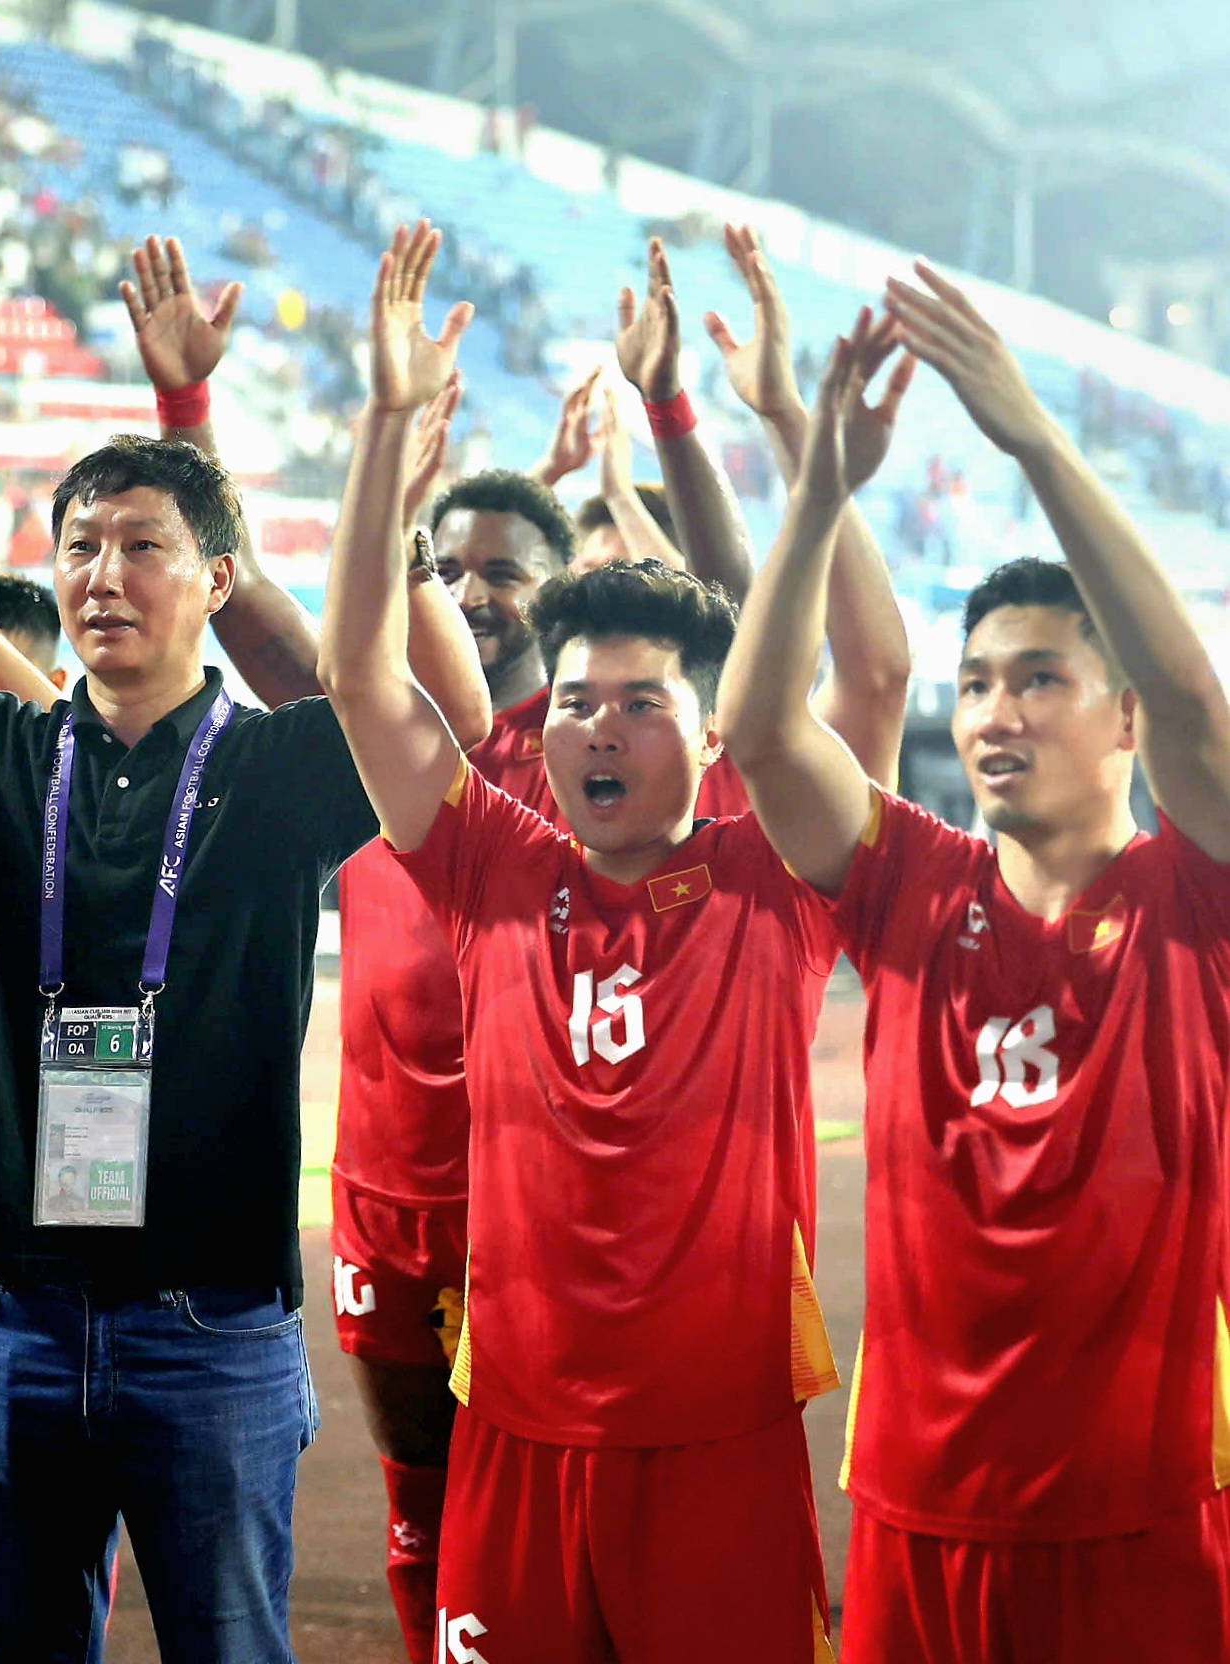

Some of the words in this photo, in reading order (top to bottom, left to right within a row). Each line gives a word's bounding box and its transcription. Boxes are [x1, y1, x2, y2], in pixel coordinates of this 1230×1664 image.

[55, 725, 70, 749] ASIAN
[197, 703, 231, 758] CONFEDERATION
[48, 752, 64, 803] FOOTBALL
[181, 758, 205, 811] FOOTBALL
[173, 813, 190, 848] ASIAN
[44, 805, 59, 899] CONFEDERATION
[159, 854, 181, 898] AFC
[67, 1025, 89, 1036] FOP
[569, 963, 646, 1066] 15
[68, 1043, 85, 1055] OA
[110, 1034, 120, 1053] 6
[971, 1004, 1058, 1109] 18
[90, 1186, 131, 1202] OFFICIAL
[98, 1170, 125, 1185] TEAM
